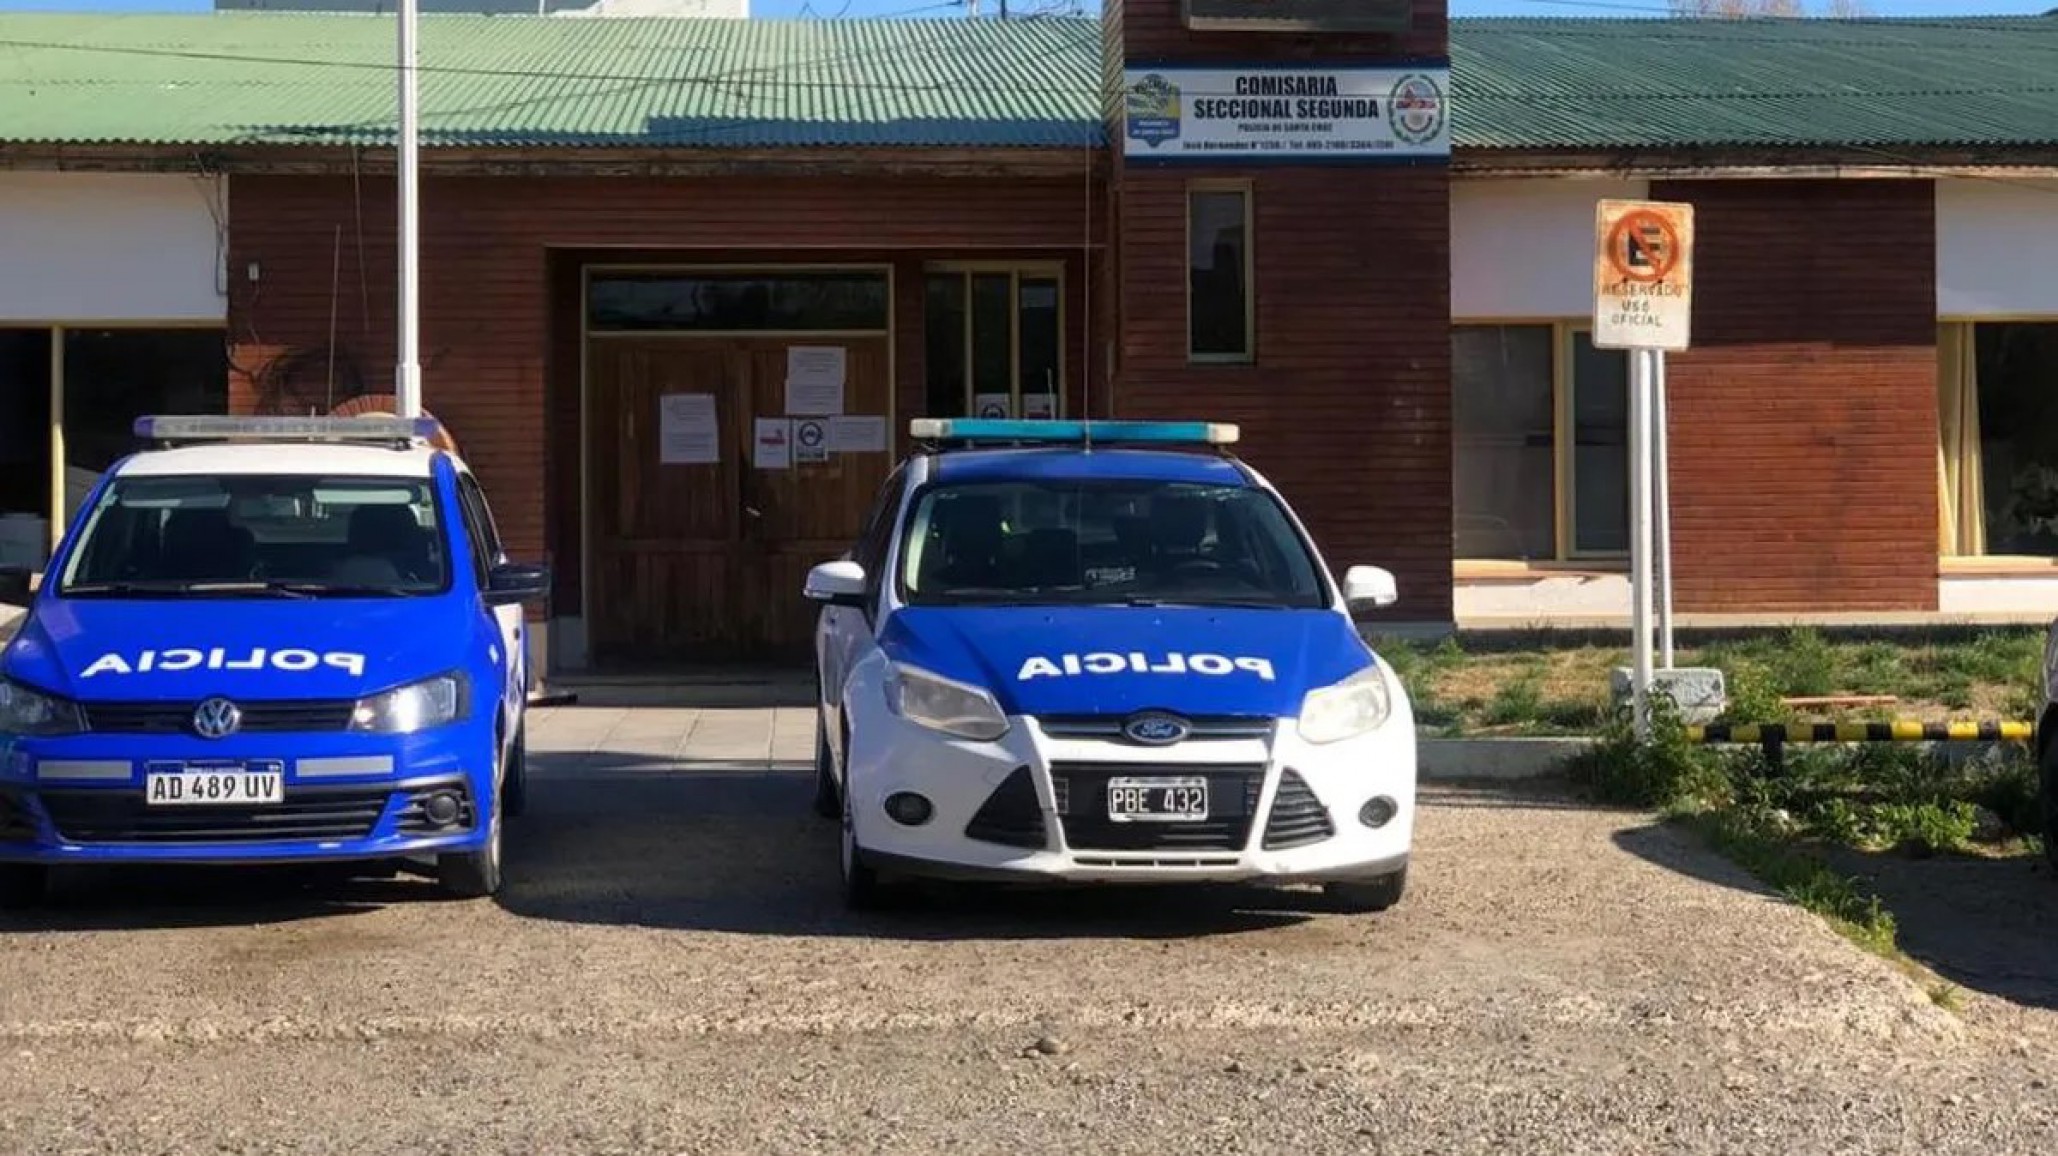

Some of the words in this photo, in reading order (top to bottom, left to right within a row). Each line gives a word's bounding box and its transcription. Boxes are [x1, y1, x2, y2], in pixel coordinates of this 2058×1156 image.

[1235, 75, 1338, 97] COMISARIA
[1193, 98, 1292, 119] SECCIONAL
[1296, 98, 1379, 119] SEGUNDA
[1621, 299, 1649, 313] USO
[1612, 314, 1662, 327] OFICIAL
[153, 775, 183, 800] AD
[191, 775, 236, 799] 489
[244, 774, 275, 798] UV
[1112, 787, 1151, 813] PBE
[1164, 787, 1203, 813] 432
